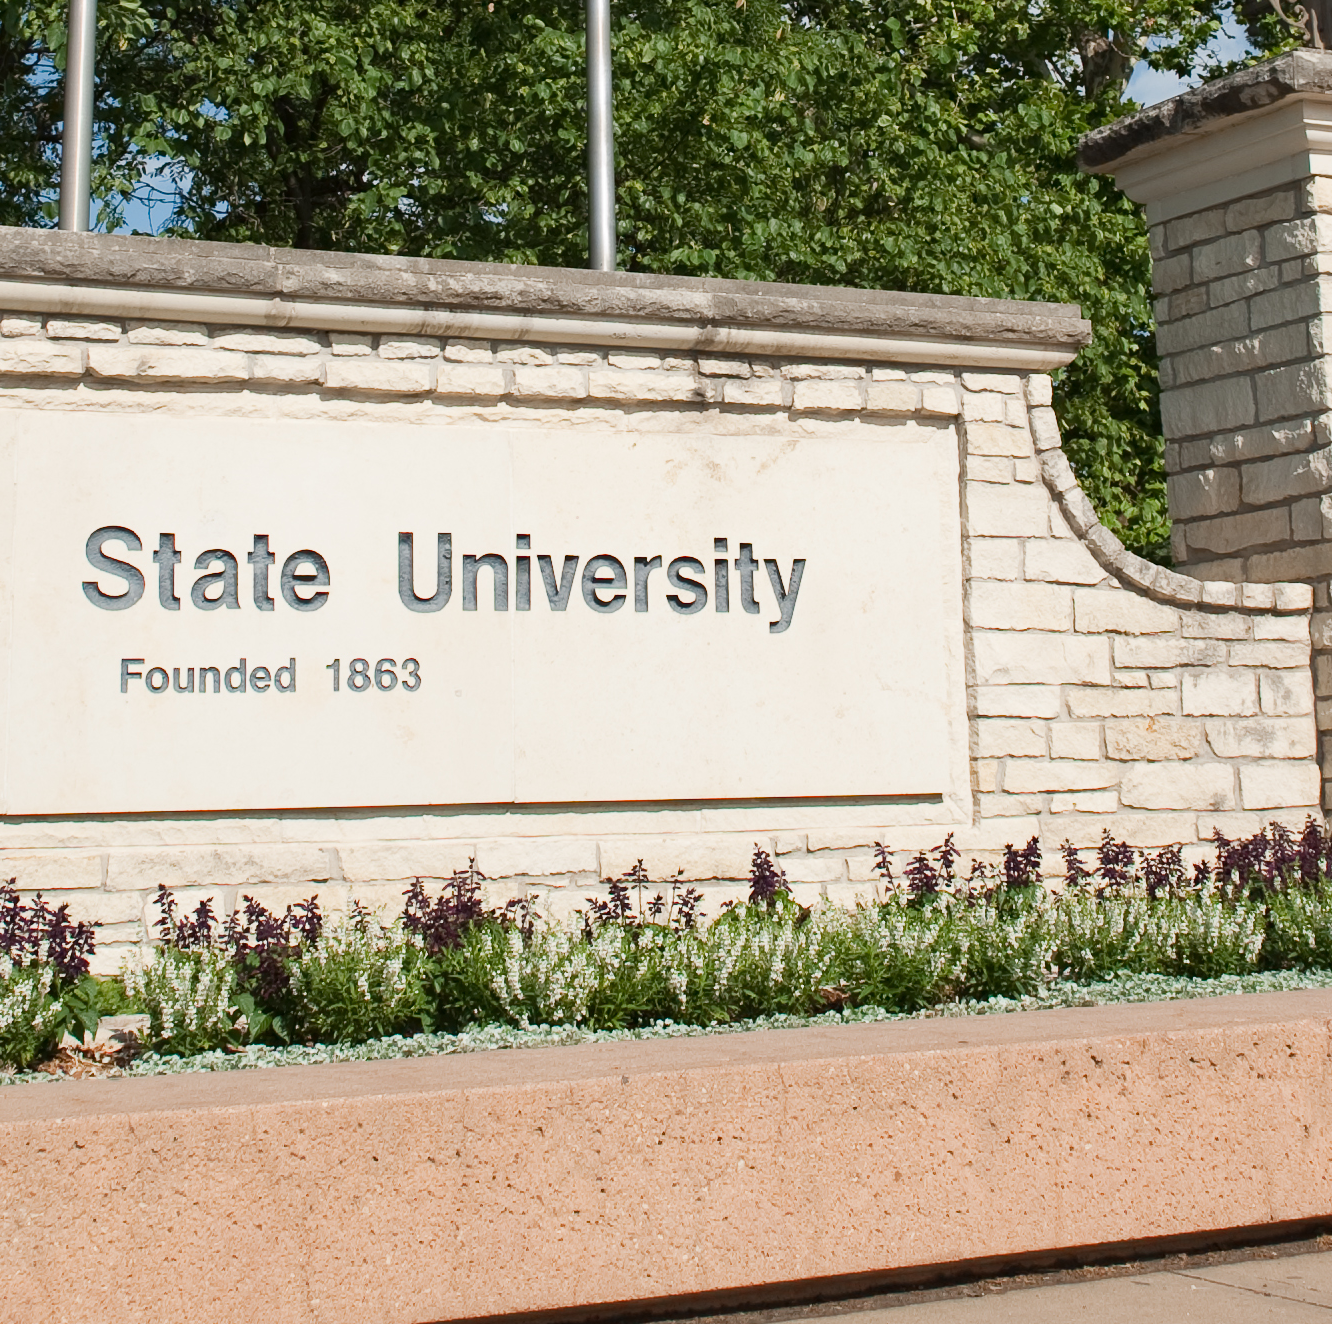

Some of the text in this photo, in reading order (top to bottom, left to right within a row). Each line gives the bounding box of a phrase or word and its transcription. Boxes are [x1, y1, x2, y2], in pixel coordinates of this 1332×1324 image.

[82, 526, 331, 612] State
[398, 531, 807, 634] University
[120, 657, 422, 694] Founded 1863
